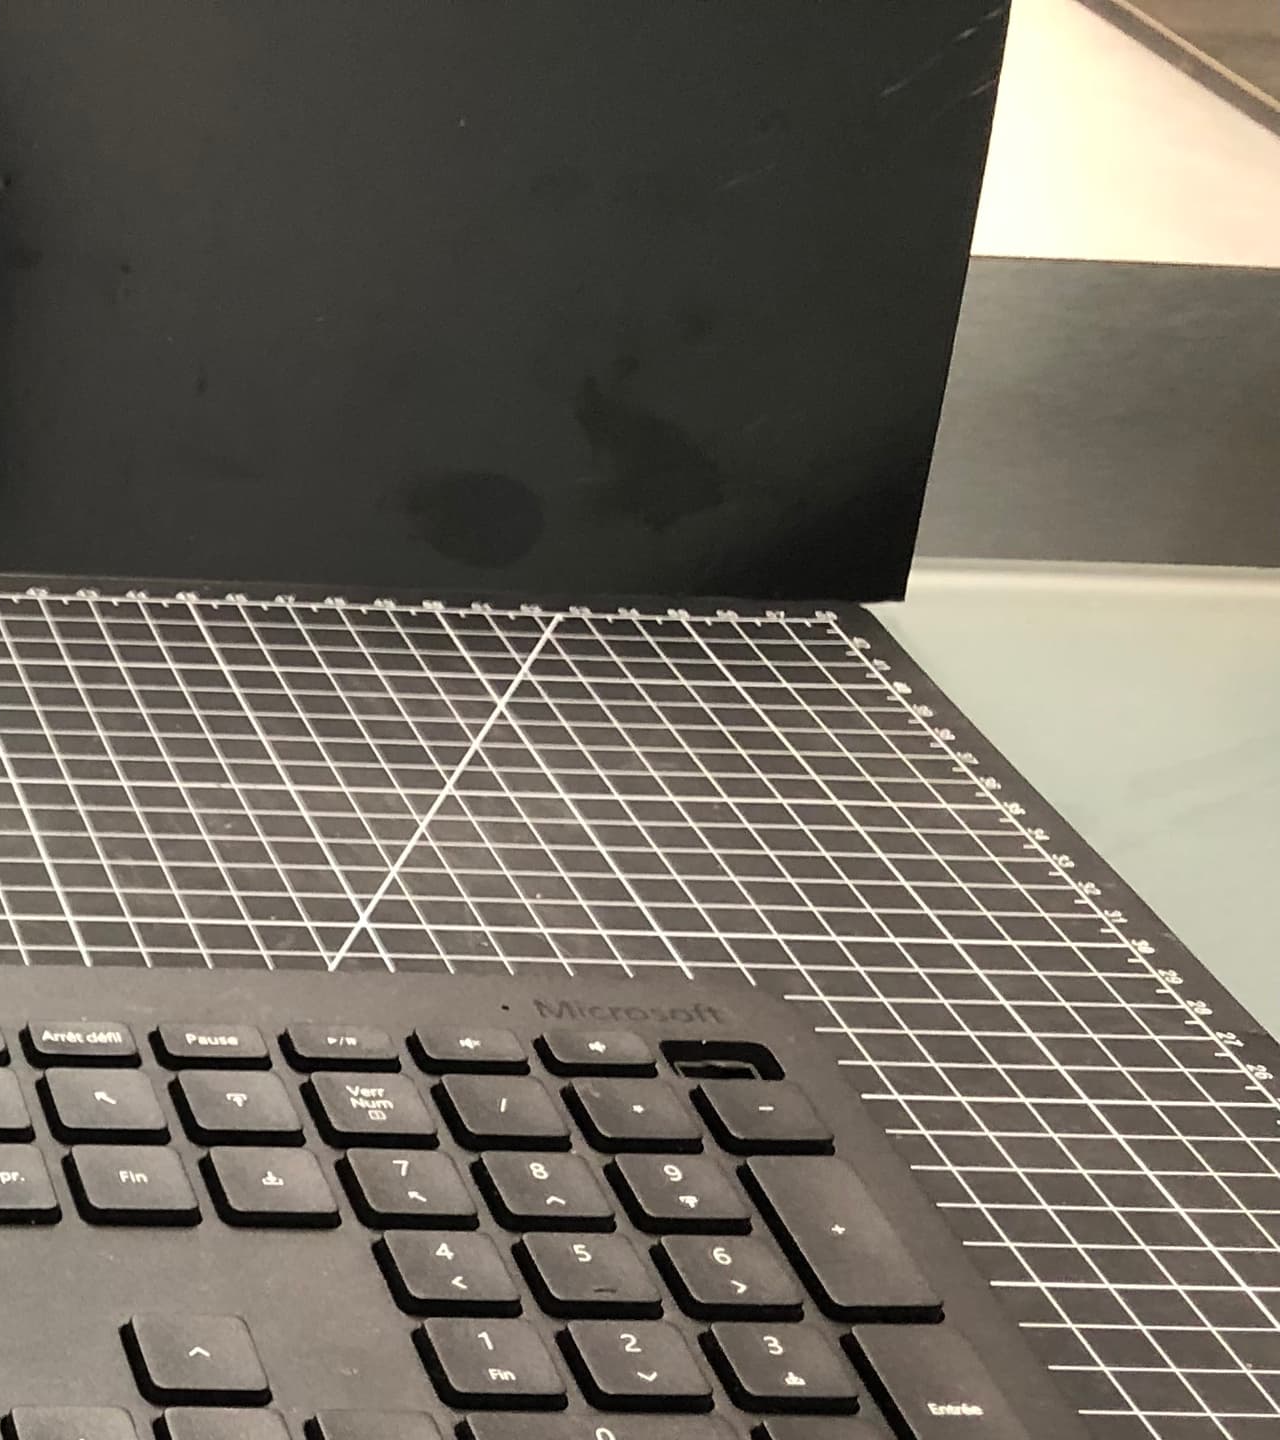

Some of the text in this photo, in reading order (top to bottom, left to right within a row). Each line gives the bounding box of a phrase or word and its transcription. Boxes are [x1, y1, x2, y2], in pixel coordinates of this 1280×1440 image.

[1158, 969, 1183, 984] 29
[533, 998, 730, 1025] Microsoft
[185, 1033, 238, 1045] Pause
[1215, 1031, 1245, 1047] 27
[1245, 1063, 1273, 1081] 26
[346, 1085, 384, 1100] Verr
[350, 1097, 394, 1111] Num
[119, 1170, 148, 1183] Fin
[392, 1160, 409, 1176] 7
[529, 1162, 549, 1179] 8
[664, 1164, 682, 1181] 9
[436, 1243, 454, 1260] 4
[573, 1244, 592, 1262] 5
[713, 1247, 732, 1265] 6
[478, 1331, 493, 1350] 1
[620, 1333, 642, 1352] 2
[763, 1336, 783, 1355] 3
[488, 1368, 516, 1380] Fin
[927, 1403, 984, 1416] Entrée
